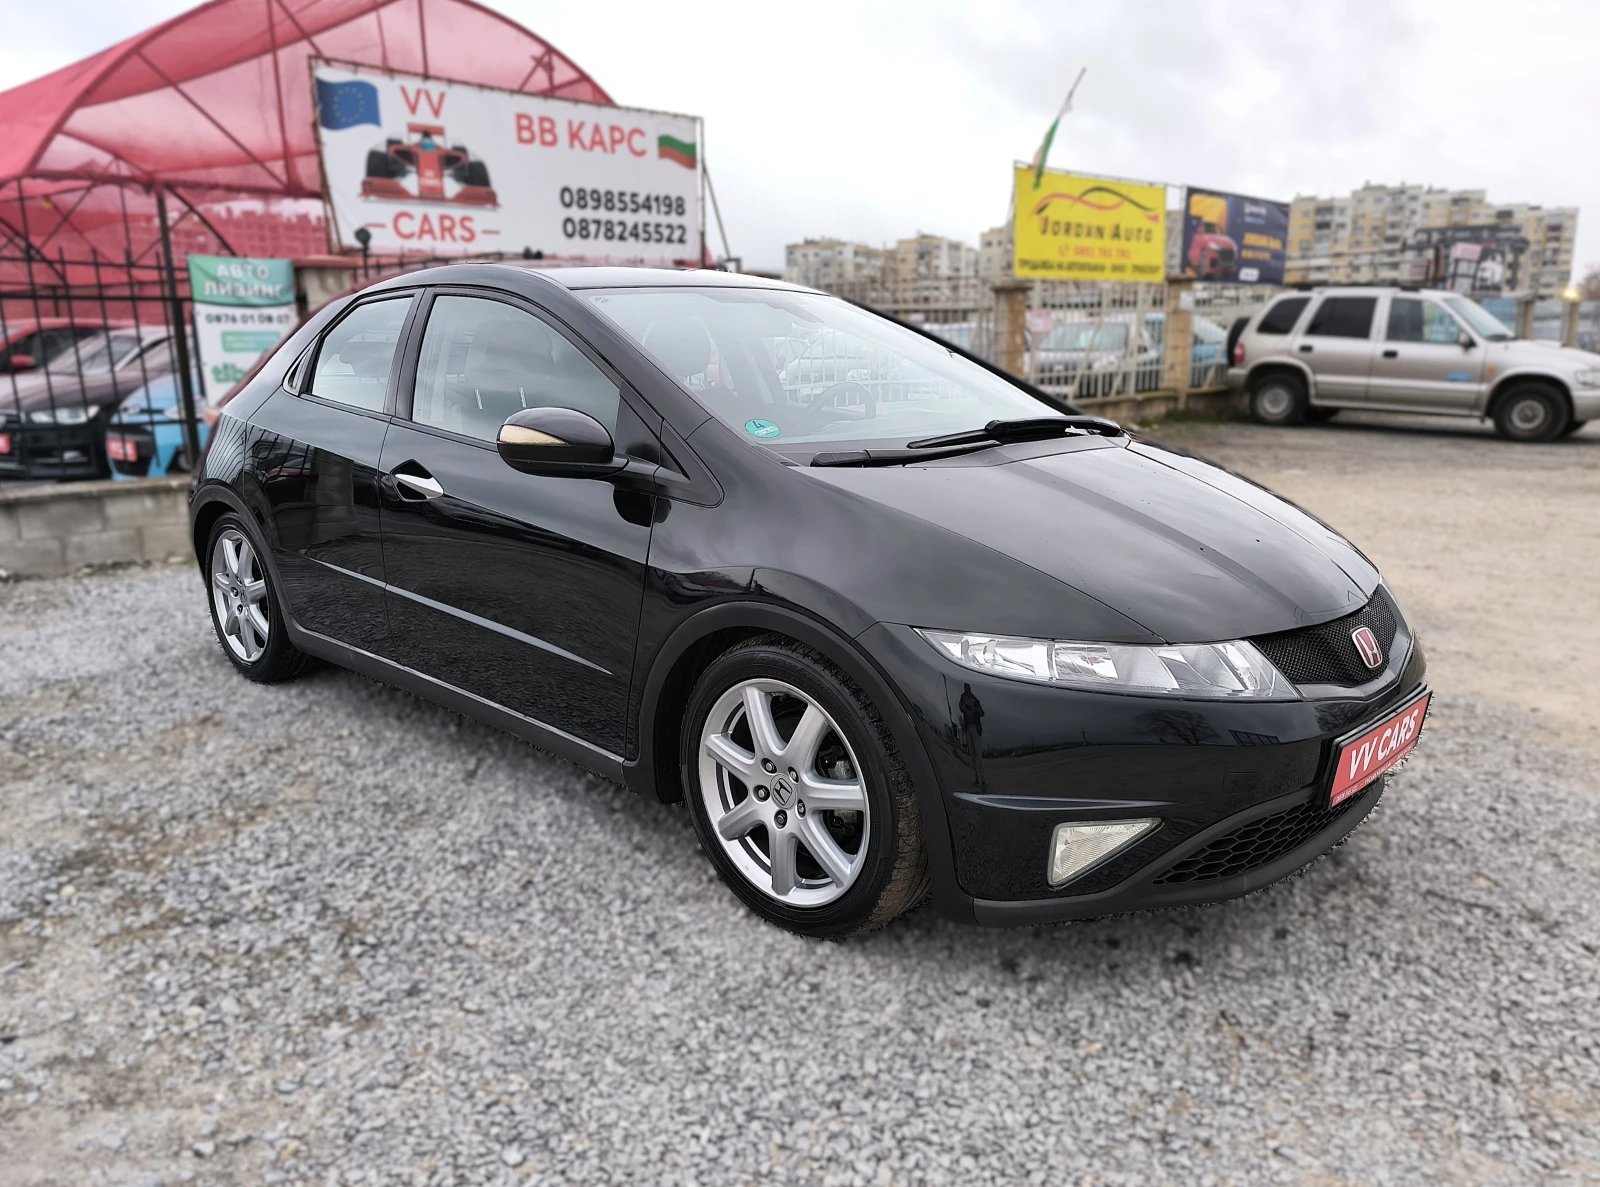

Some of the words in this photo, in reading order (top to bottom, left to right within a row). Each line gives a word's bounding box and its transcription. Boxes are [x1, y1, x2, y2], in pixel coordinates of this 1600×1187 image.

[400, 86, 446, 119] VV
[560, 186, 685, 216] 0898554198
[393, 211, 477, 243] CARS
[563, 217, 687, 244] 0878245522
[216, 263, 270, 280] АВТО
[1350, 736, 1378, 780] VV
[1377, 708, 1419, 761] CARS
